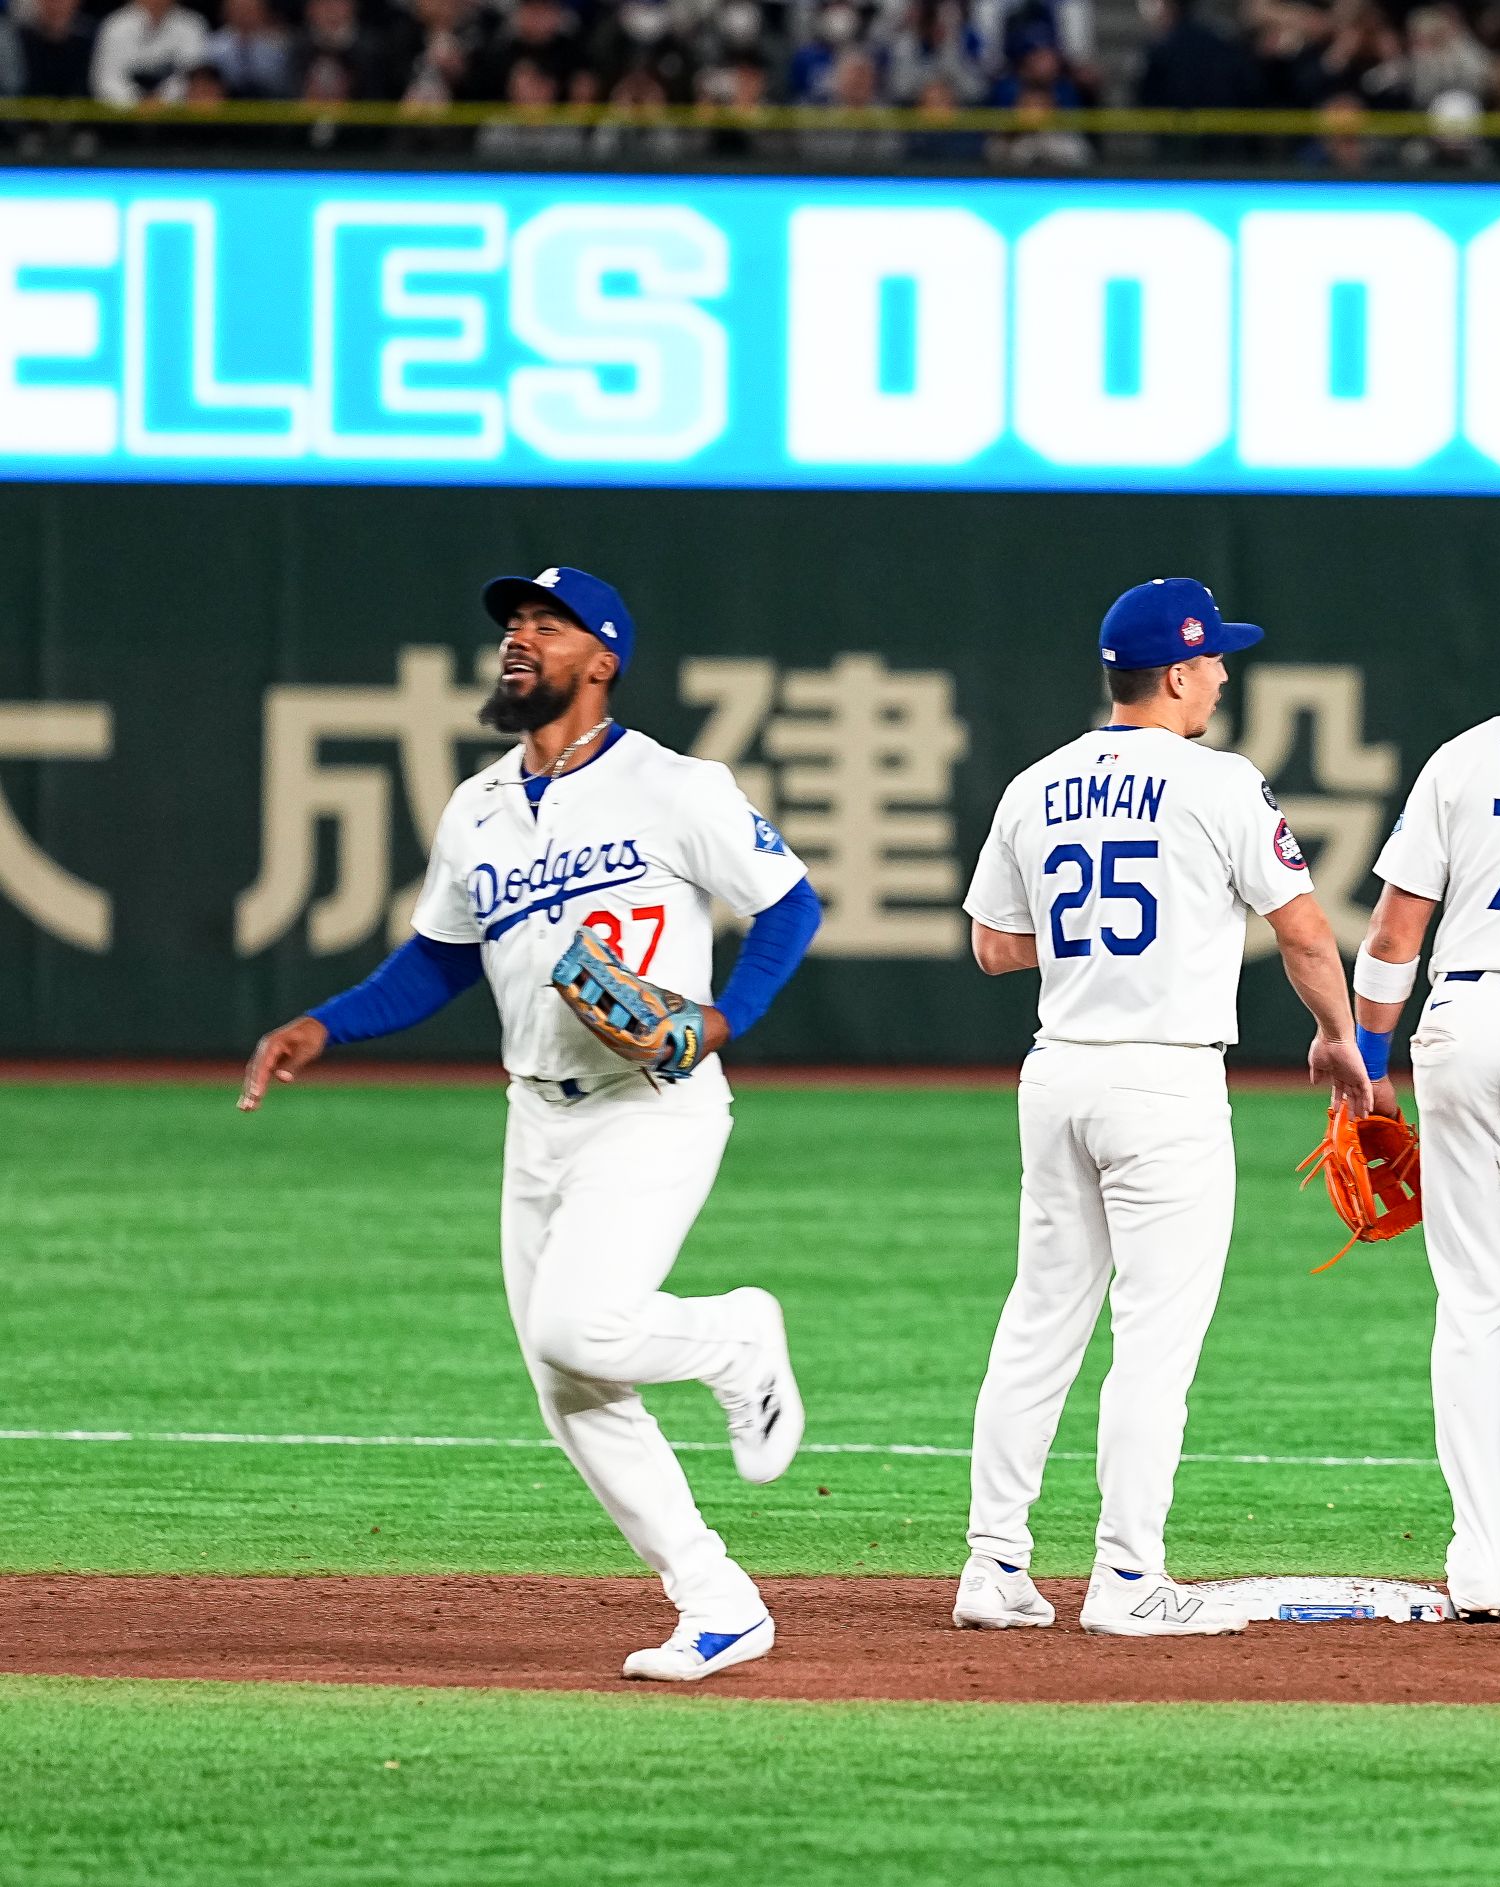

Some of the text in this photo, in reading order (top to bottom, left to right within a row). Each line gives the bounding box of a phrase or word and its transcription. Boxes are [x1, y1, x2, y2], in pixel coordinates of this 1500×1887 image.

[1045, 773, 1166, 826] EDMAN
[468, 838, 647, 935] Dodgers
[1043, 840, 1159, 959] 25
